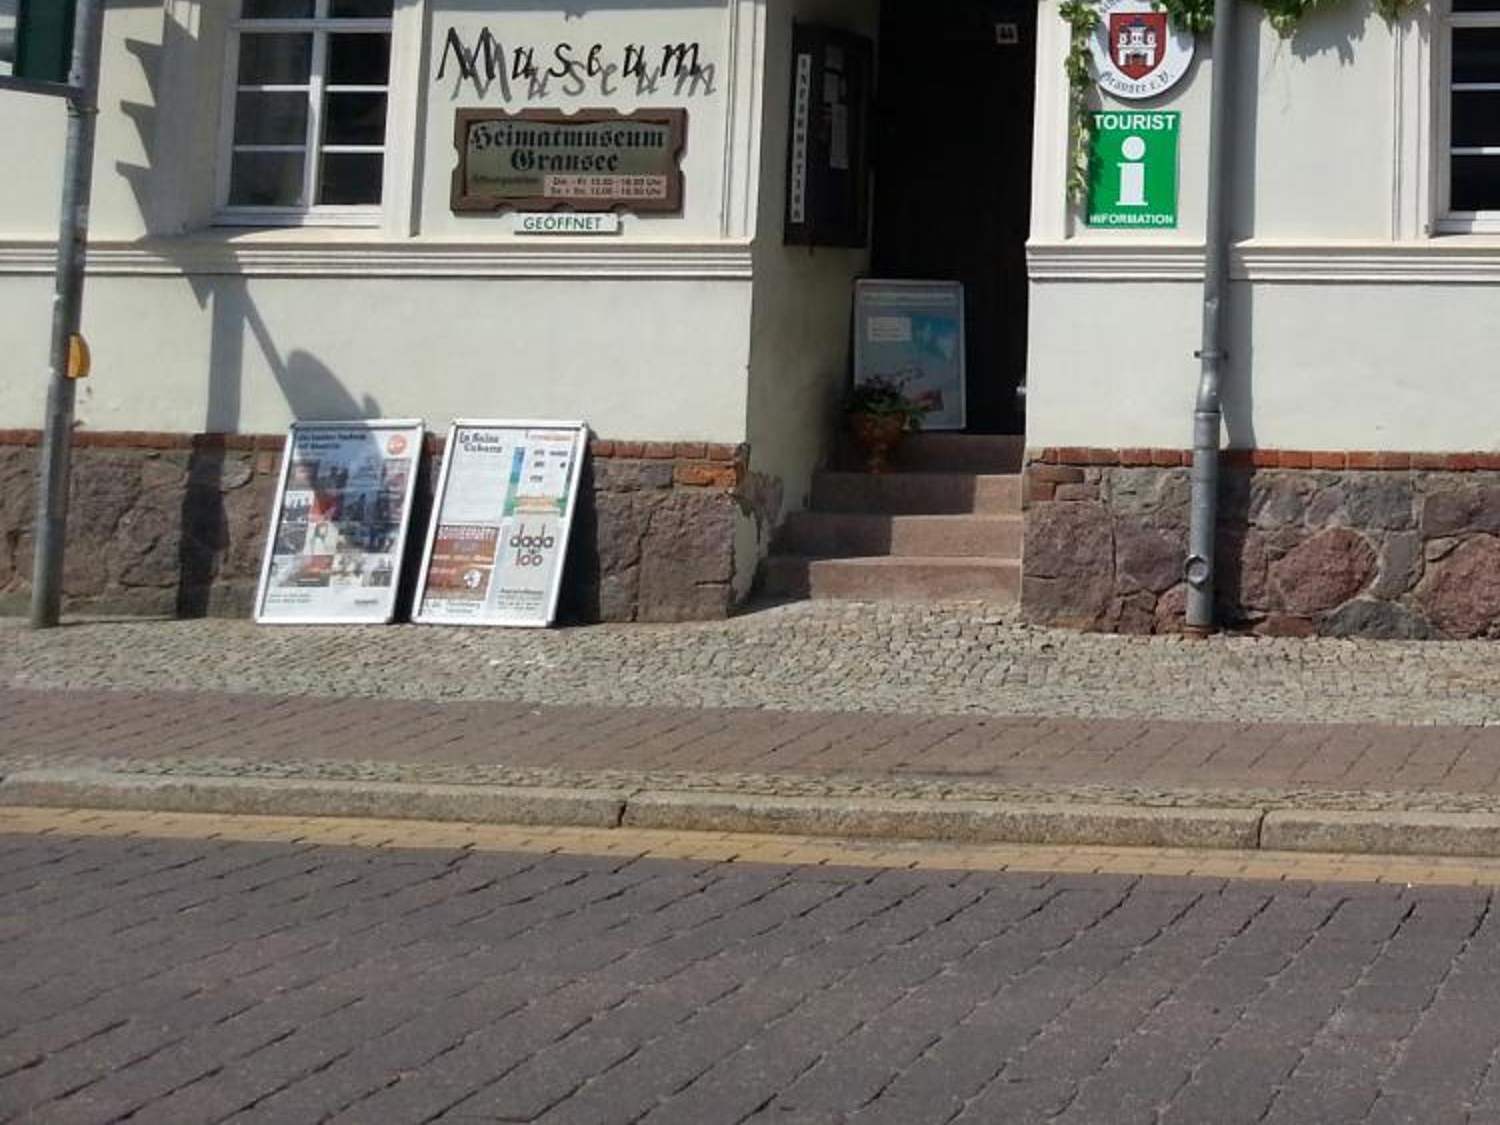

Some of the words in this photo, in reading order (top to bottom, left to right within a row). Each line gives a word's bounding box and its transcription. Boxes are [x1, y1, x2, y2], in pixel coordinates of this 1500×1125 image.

[437, 26, 700, 81] Museum
[1095, 114, 1176, 130] TOURIST
[471, 125, 664, 150] Heimatmuseum
[794, 57, 809, 219] INFORMATION
[511, 148, 619, 172] Gransee
[524, 215, 602, 230] GEÖFFNET
[1090, 213, 1174, 225] INFORMATION
[509, 523, 554, 548] dada
